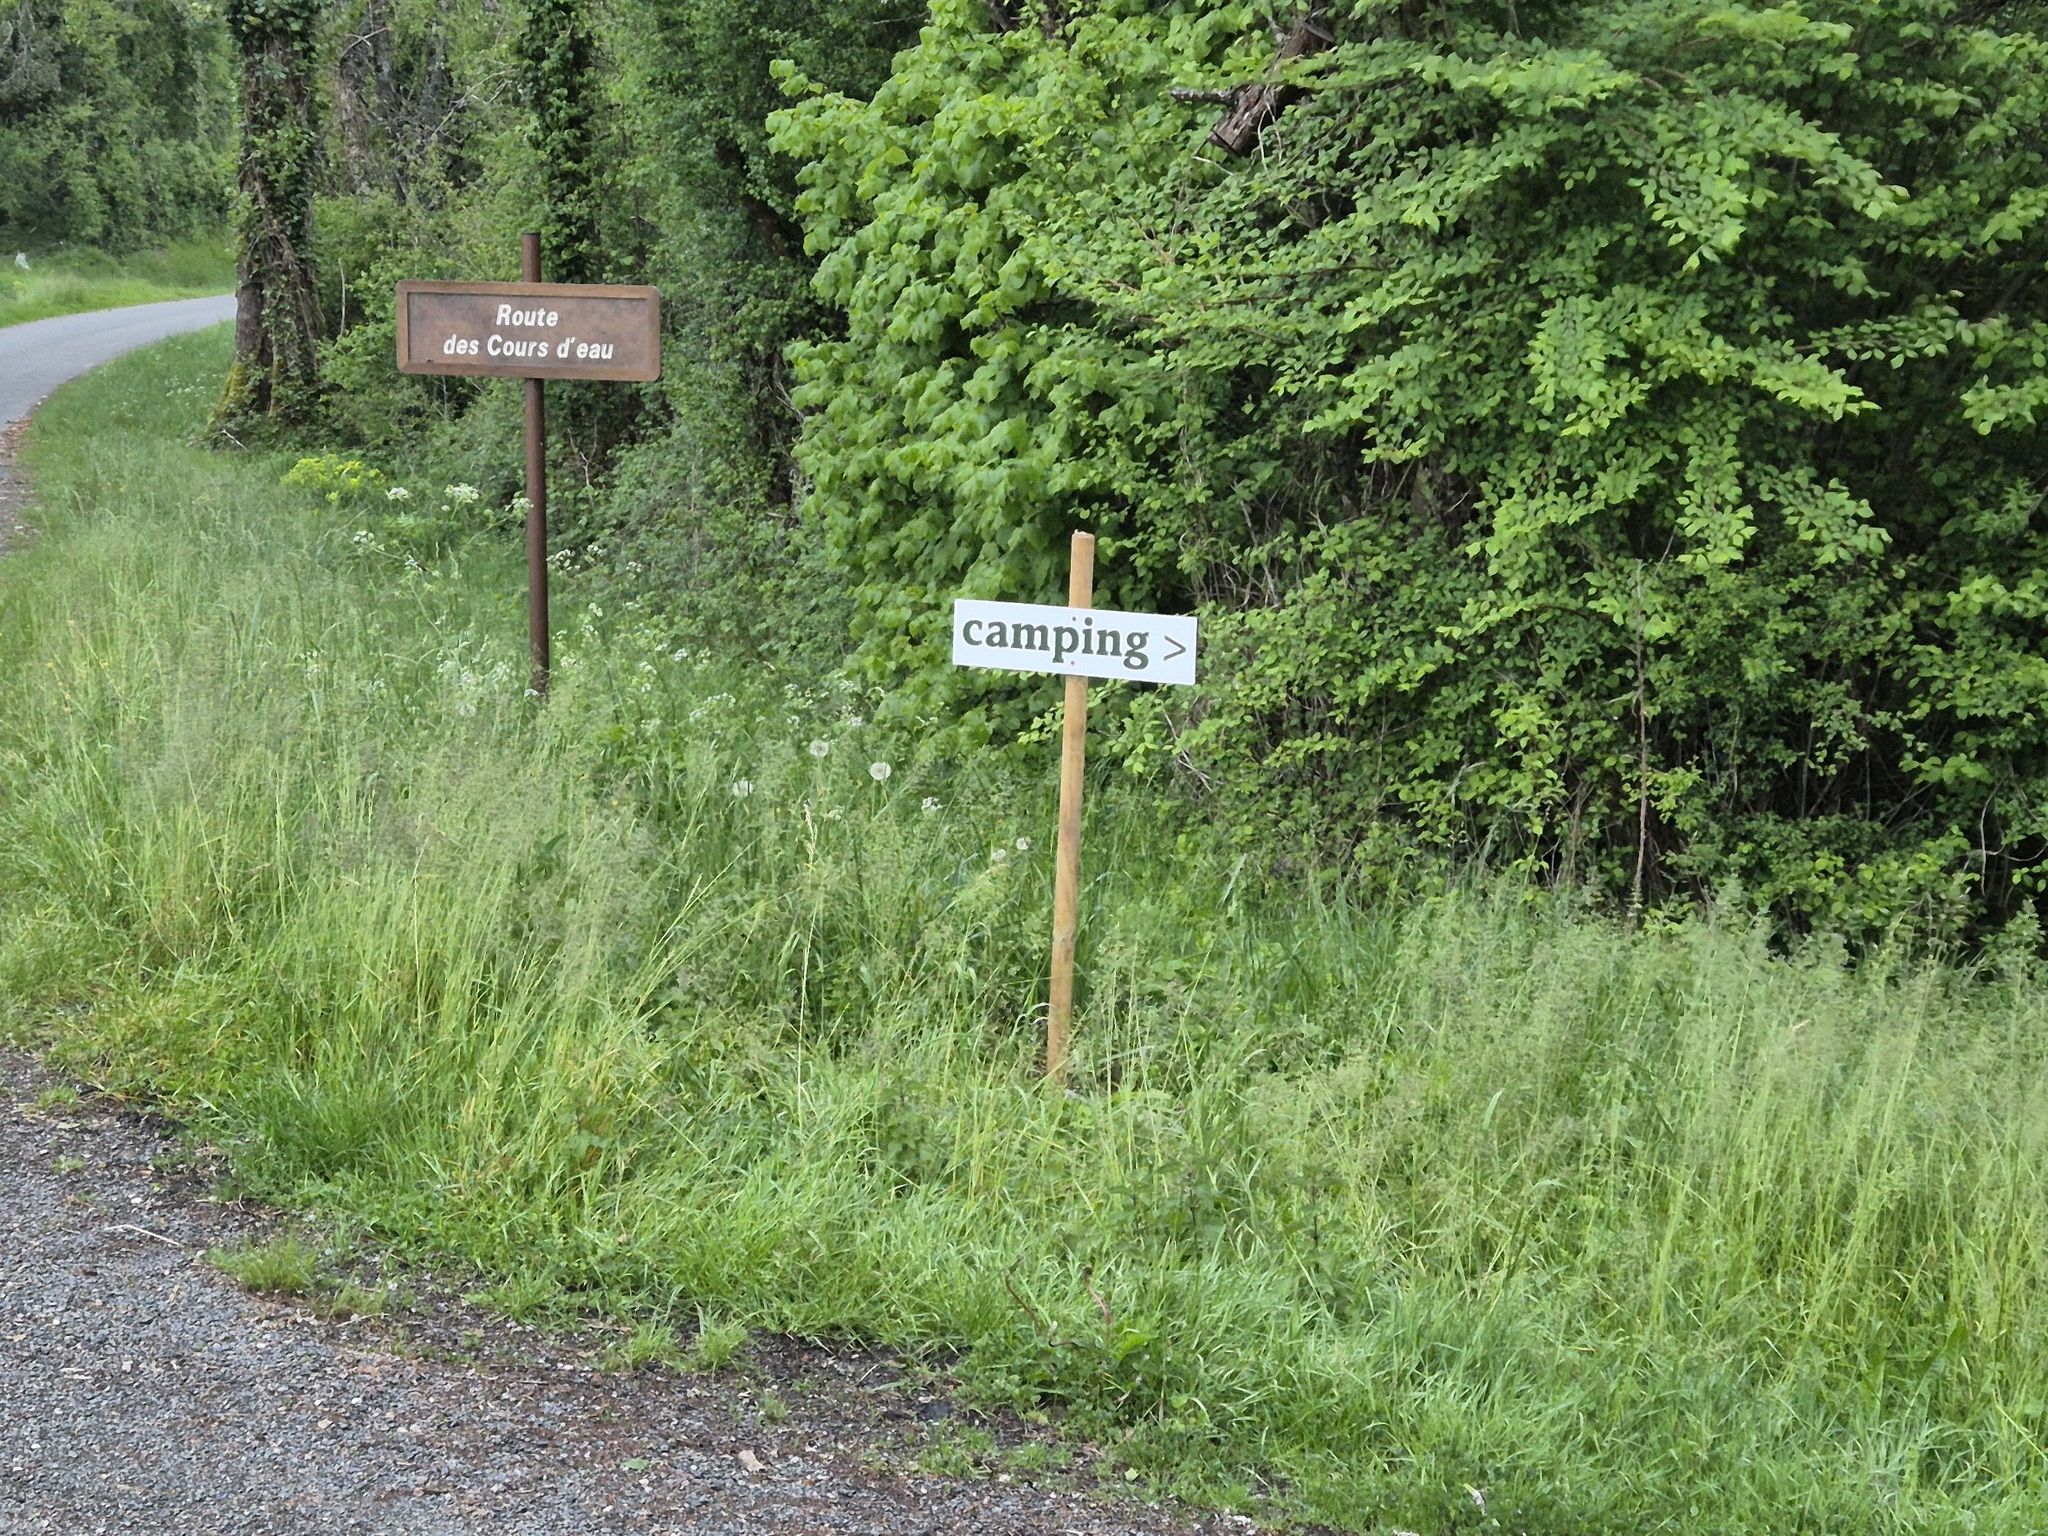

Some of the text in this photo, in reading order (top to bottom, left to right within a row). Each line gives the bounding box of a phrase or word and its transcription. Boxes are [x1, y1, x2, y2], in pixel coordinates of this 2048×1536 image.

[496, 304, 559, 327] Route
[443, 334, 614, 360] des Cours d'eau
[962, 616, 1150, 670] camping
